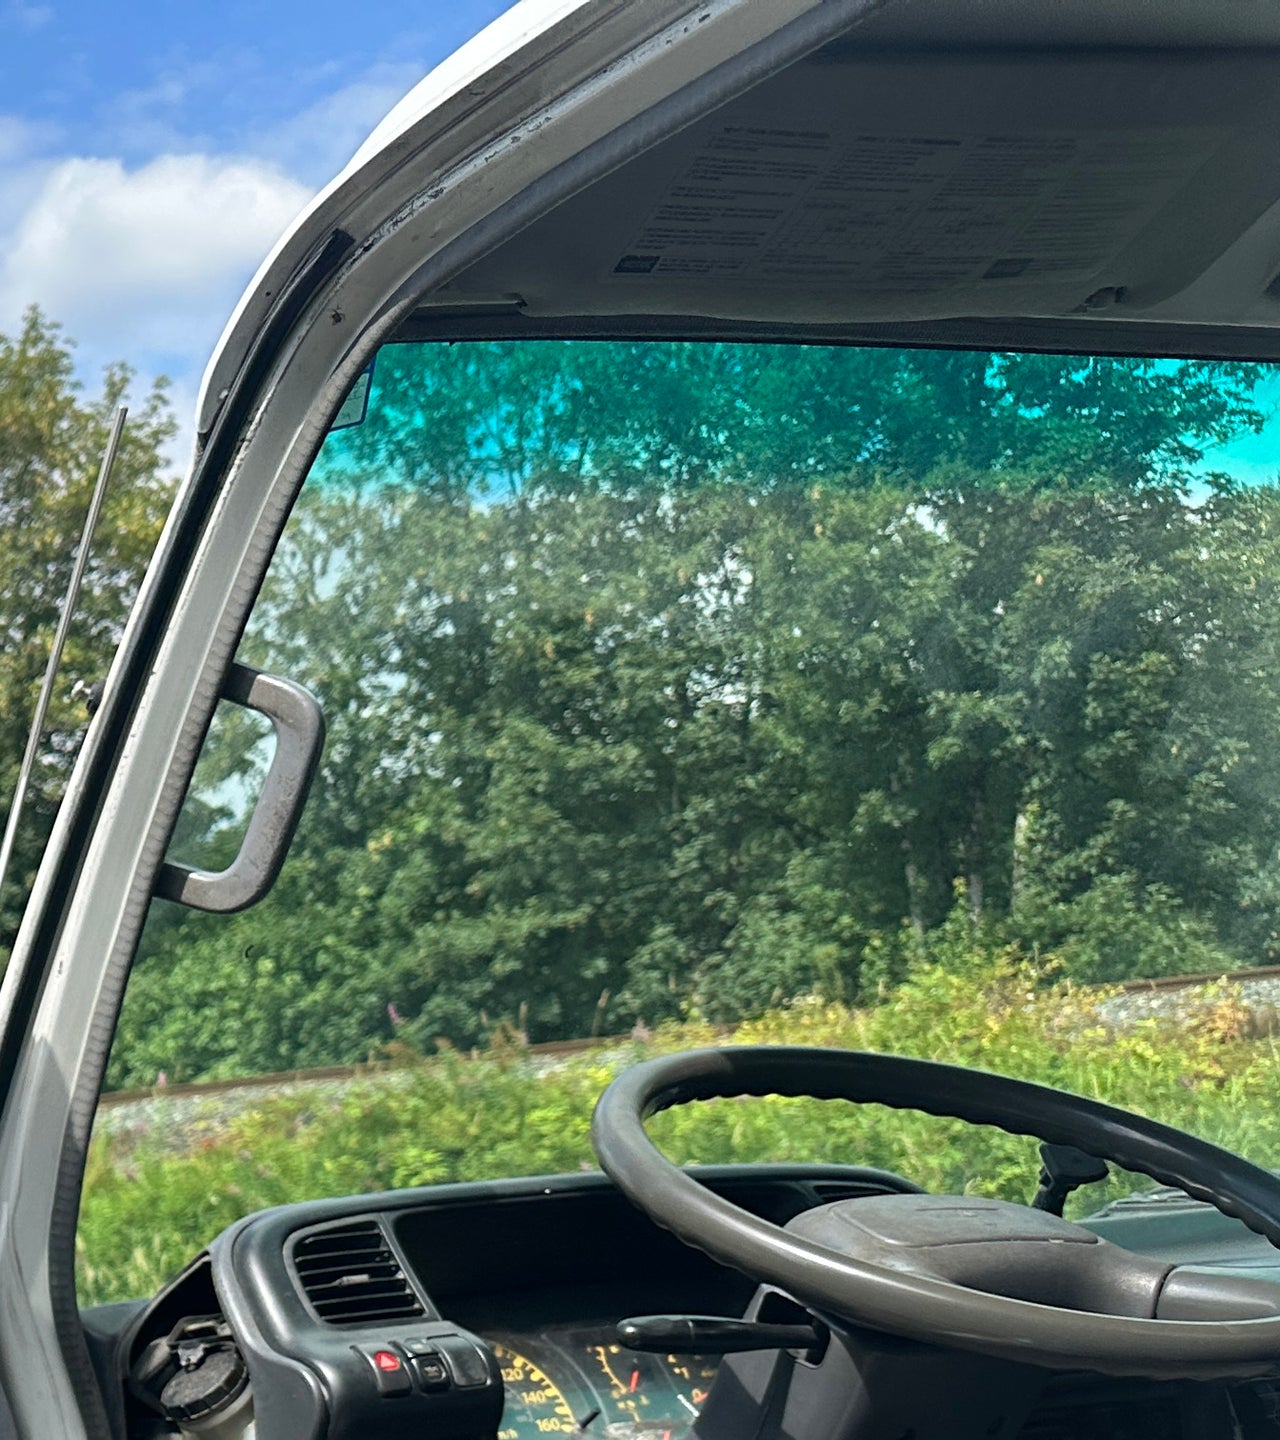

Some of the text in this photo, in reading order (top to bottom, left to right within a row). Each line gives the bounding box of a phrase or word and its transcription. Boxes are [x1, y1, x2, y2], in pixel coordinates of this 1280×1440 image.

[500, 1367, 524, 1381] 120
[521, 1389, 546, 1403] 140
[535, 1417, 560, 1431] 160
